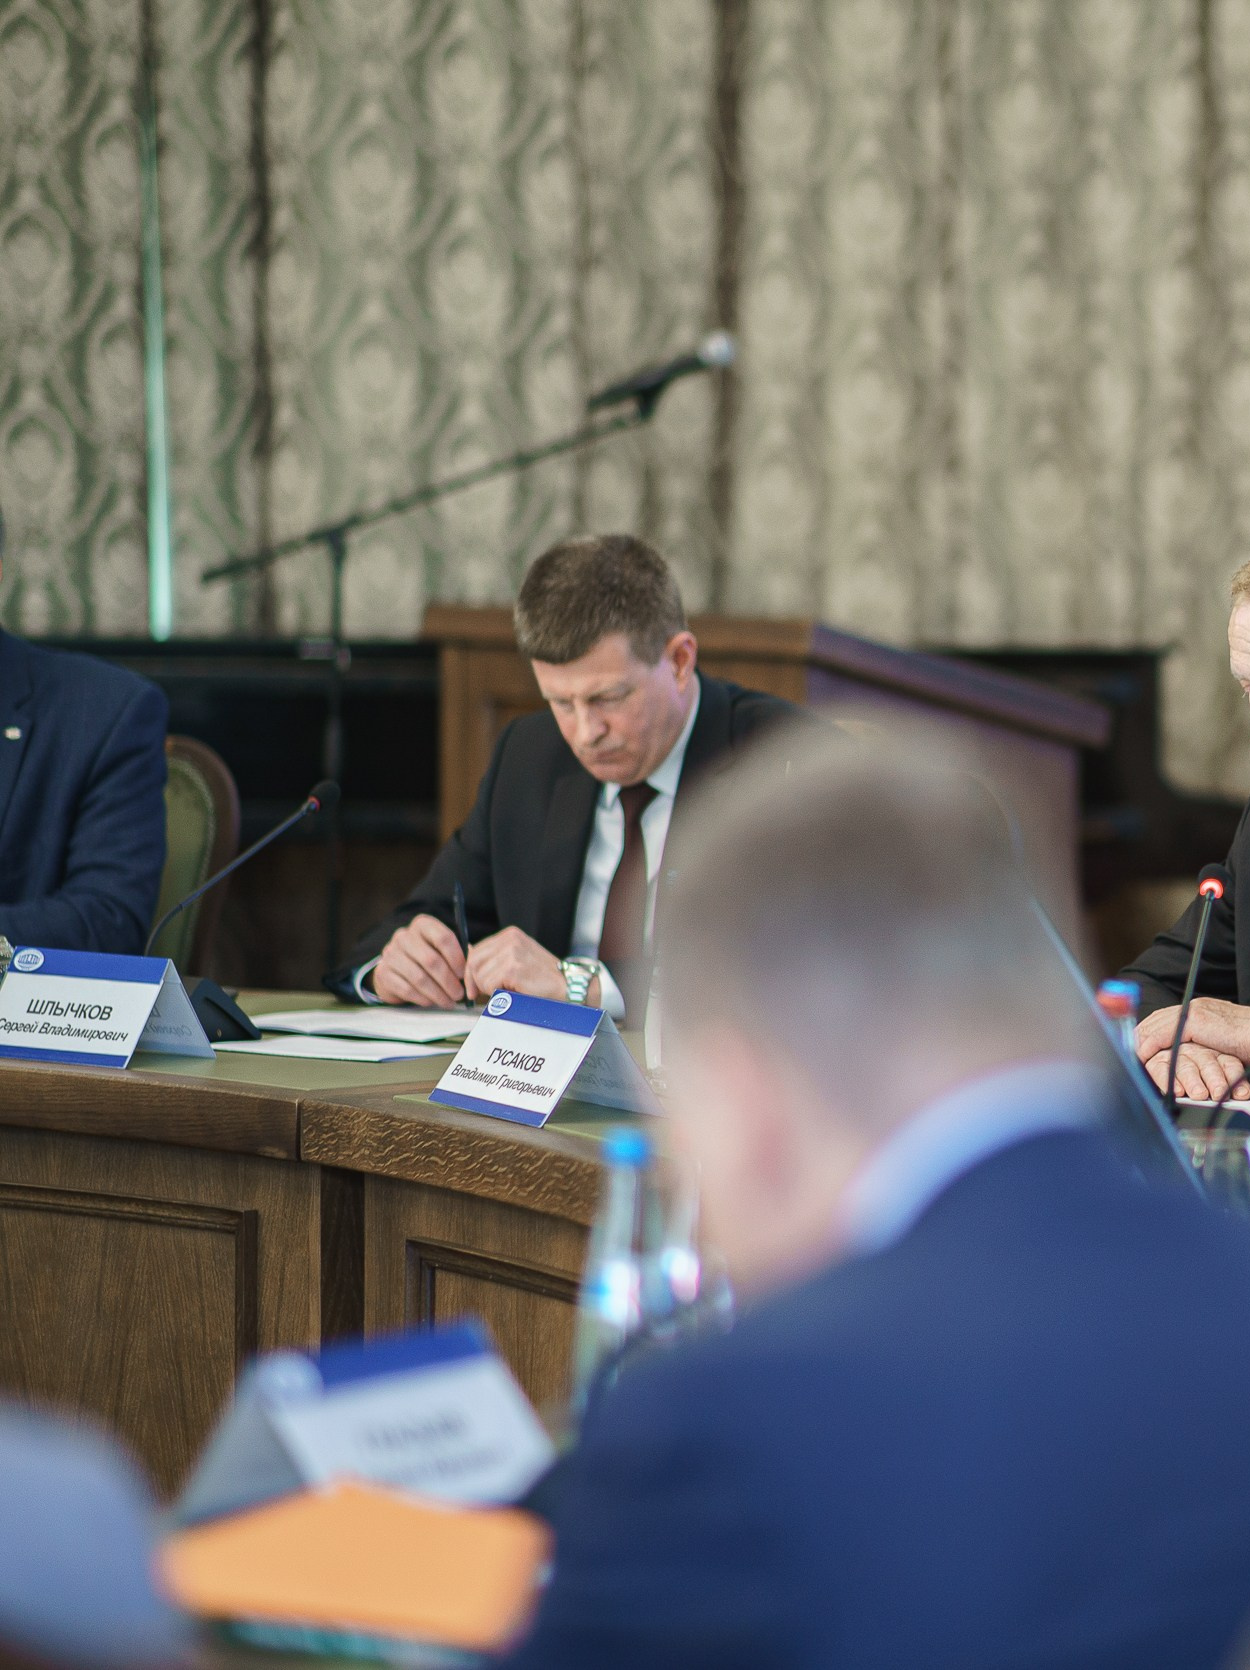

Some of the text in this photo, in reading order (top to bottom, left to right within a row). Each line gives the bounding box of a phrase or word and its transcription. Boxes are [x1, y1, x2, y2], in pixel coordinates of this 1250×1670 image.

[26, 999, 113, 1021] ШЛЫЧКОВ
[0, 1017, 39, 1034] Сергей
[38, 1021, 129, 1042] Владимирович
[486, 1047, 546, 1073] ГУСАКОВ
[450, 1063, 498, 1087] Владимир
[495, 1073, 556, 1098] Григорьевич
